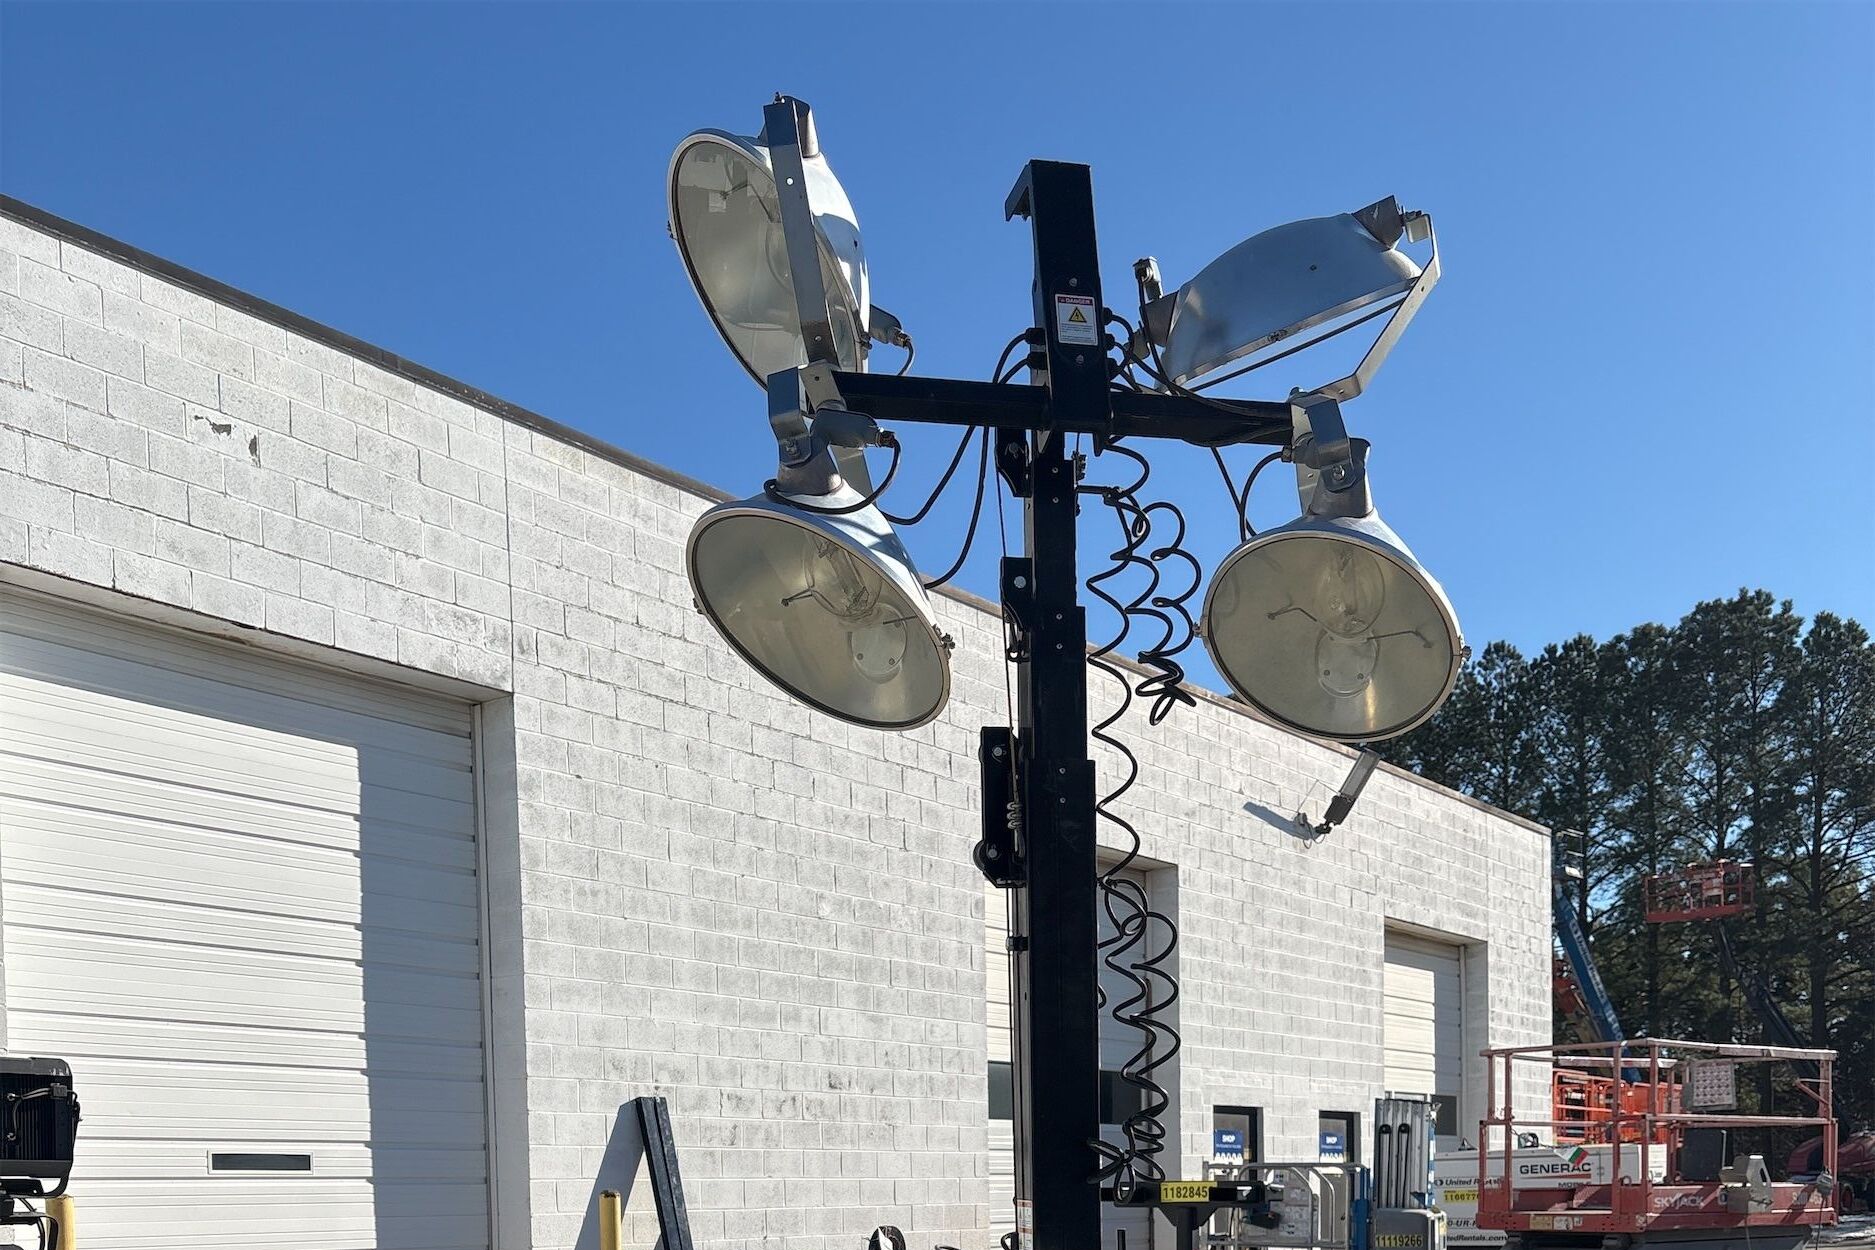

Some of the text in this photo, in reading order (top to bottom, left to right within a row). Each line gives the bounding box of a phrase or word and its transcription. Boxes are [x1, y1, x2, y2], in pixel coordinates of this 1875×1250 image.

[1519, 1162, 1592, 1174] GENERAC
[1163, 1186, 1208, 1199] 1182845
[1654, 1193, 1705, 1208] SKYJACK
[1375, 1235, 1423, 1248] 11119266
